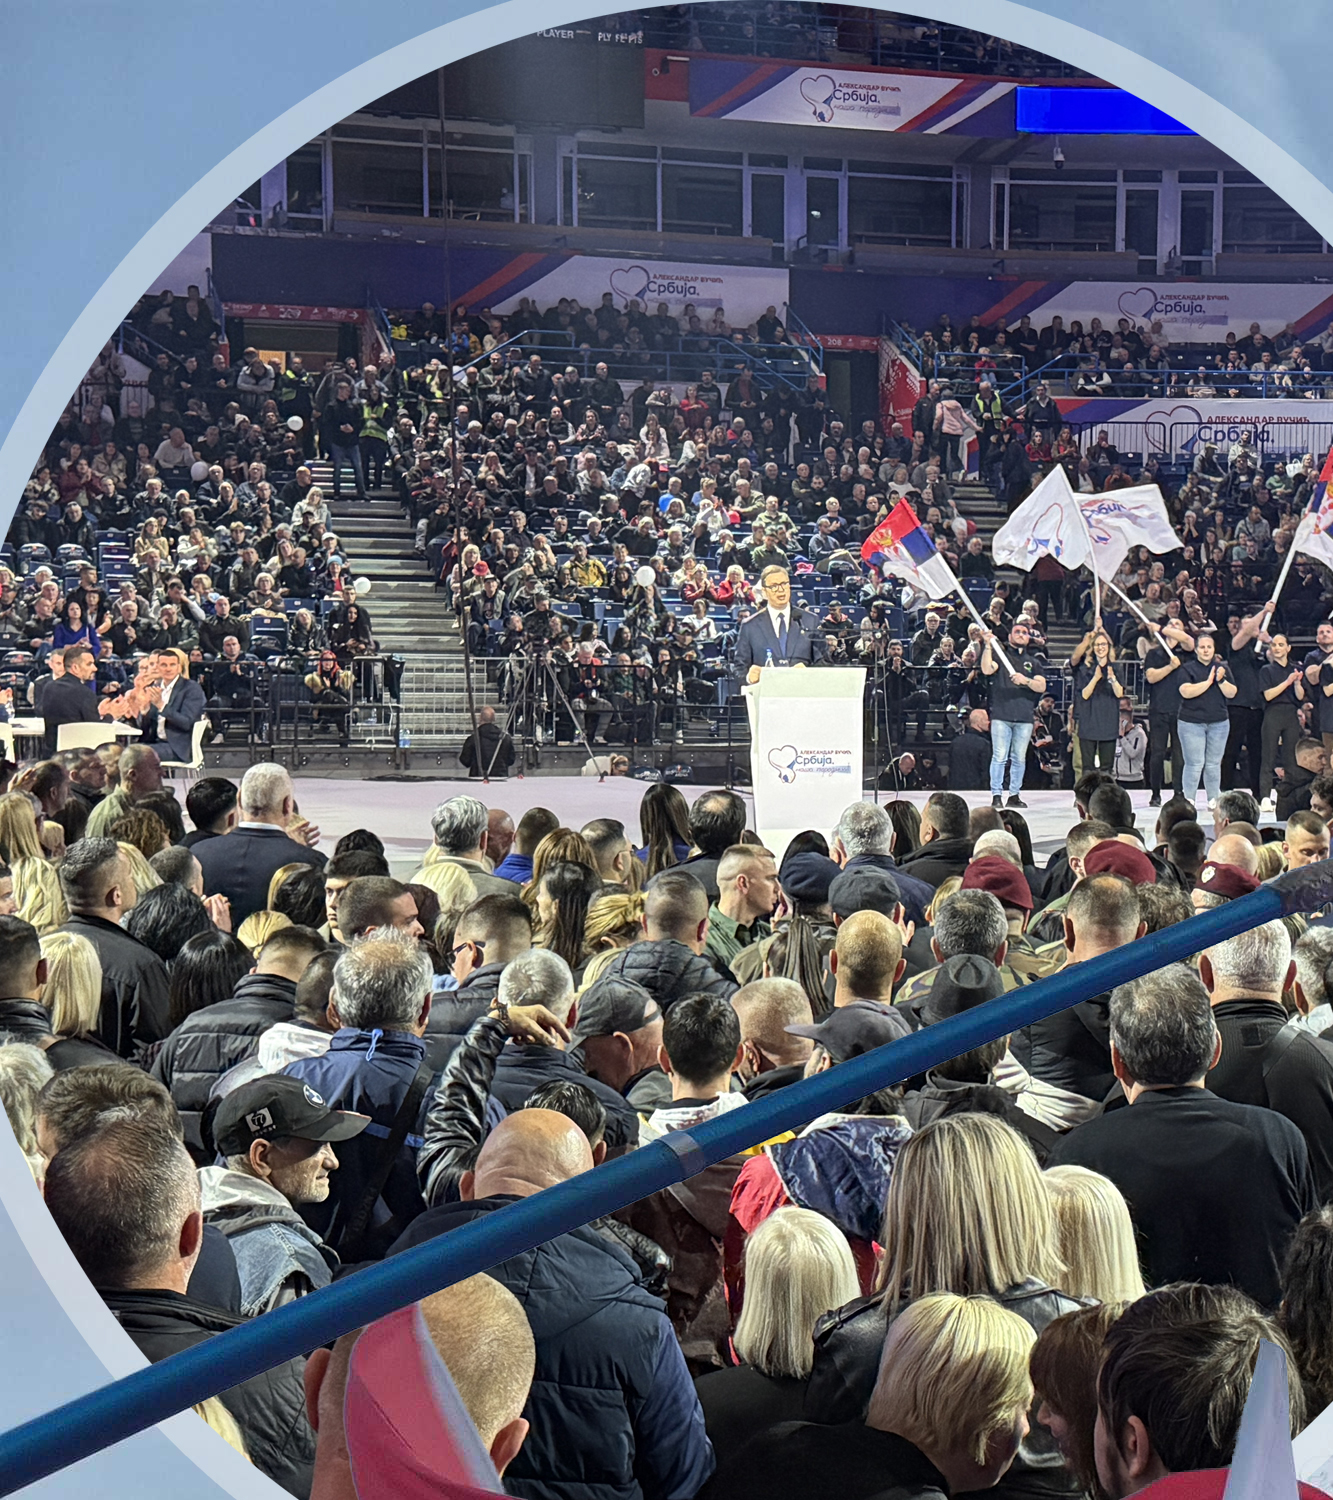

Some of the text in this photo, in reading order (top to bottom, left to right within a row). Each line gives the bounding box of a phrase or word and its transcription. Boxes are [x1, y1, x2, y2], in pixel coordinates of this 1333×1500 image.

[537, 30, 574, 39] PLAYER
[1207, 415, 1274, 425] АЛЕКСАНДАР
[1197, 425, 1274, 445] Србја,
